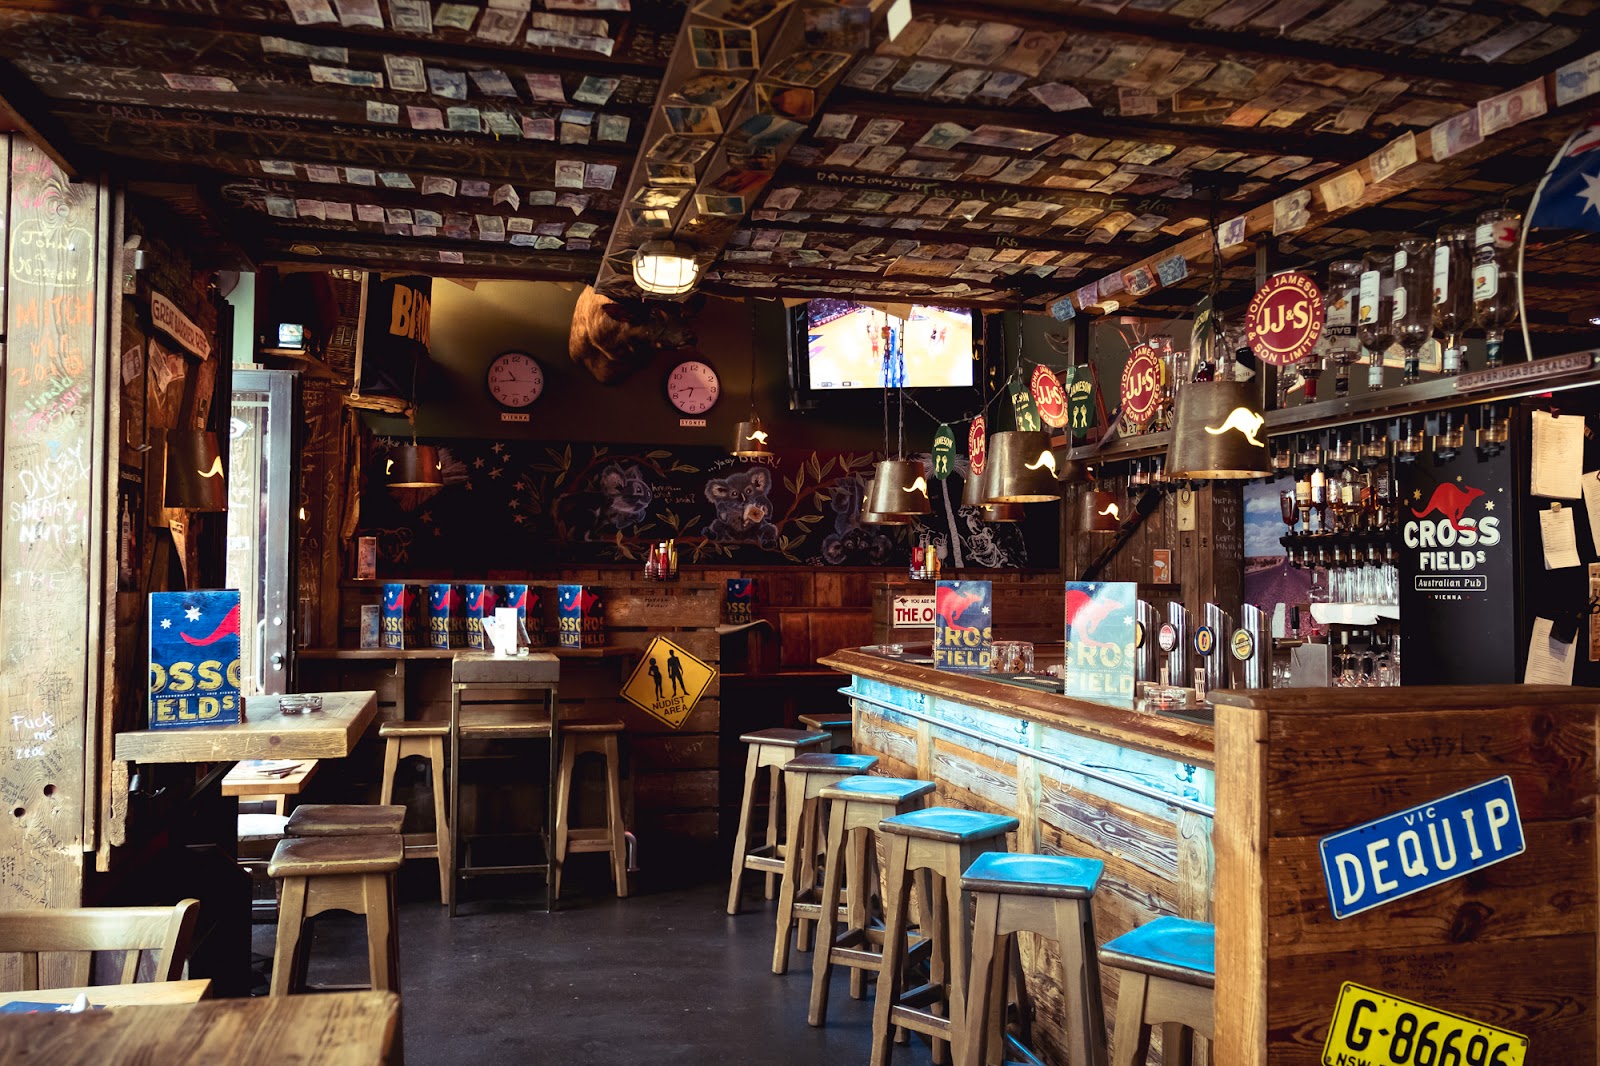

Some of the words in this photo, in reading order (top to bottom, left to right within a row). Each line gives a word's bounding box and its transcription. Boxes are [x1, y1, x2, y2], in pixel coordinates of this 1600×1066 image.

[1247, 285, 1271, 321] JOHN
[1274, 275, 1322, 308] JAMESON
[153, 299, 175, 330] GREAT
[1256, 301, 1308, 335] JJ&S
[1254, 343, 1278, 363] SON
[1282, 321, 1321, 364] LIMITED
[1134, 346, 1160, 373] JAMESON
[1070, 380, 1093, 398] JAMESON
[1126, 367, 1154, 400] JJ&S
[1038, 385, 1063, 405] JJ&S
[1404, 516, 1501, 549] CROSS
[1419, 550, 1487, 571] FIELDS
[1417, 578, 1461, 588] Australian
[1464, 578, 1482, 588] Pub
[895, 608, 919, 622] THE
[922, 607, 936, 622] O
[652, 695, 686, 711] NUDIST
[663, 704, 689, 716] AREA
[12, 711, 56, 732] Fuck
[34, 729, 58, 741] me
[1403, 806, 1437, 827] VIC
[1335, 797, 1510, 906] DEQUIP
